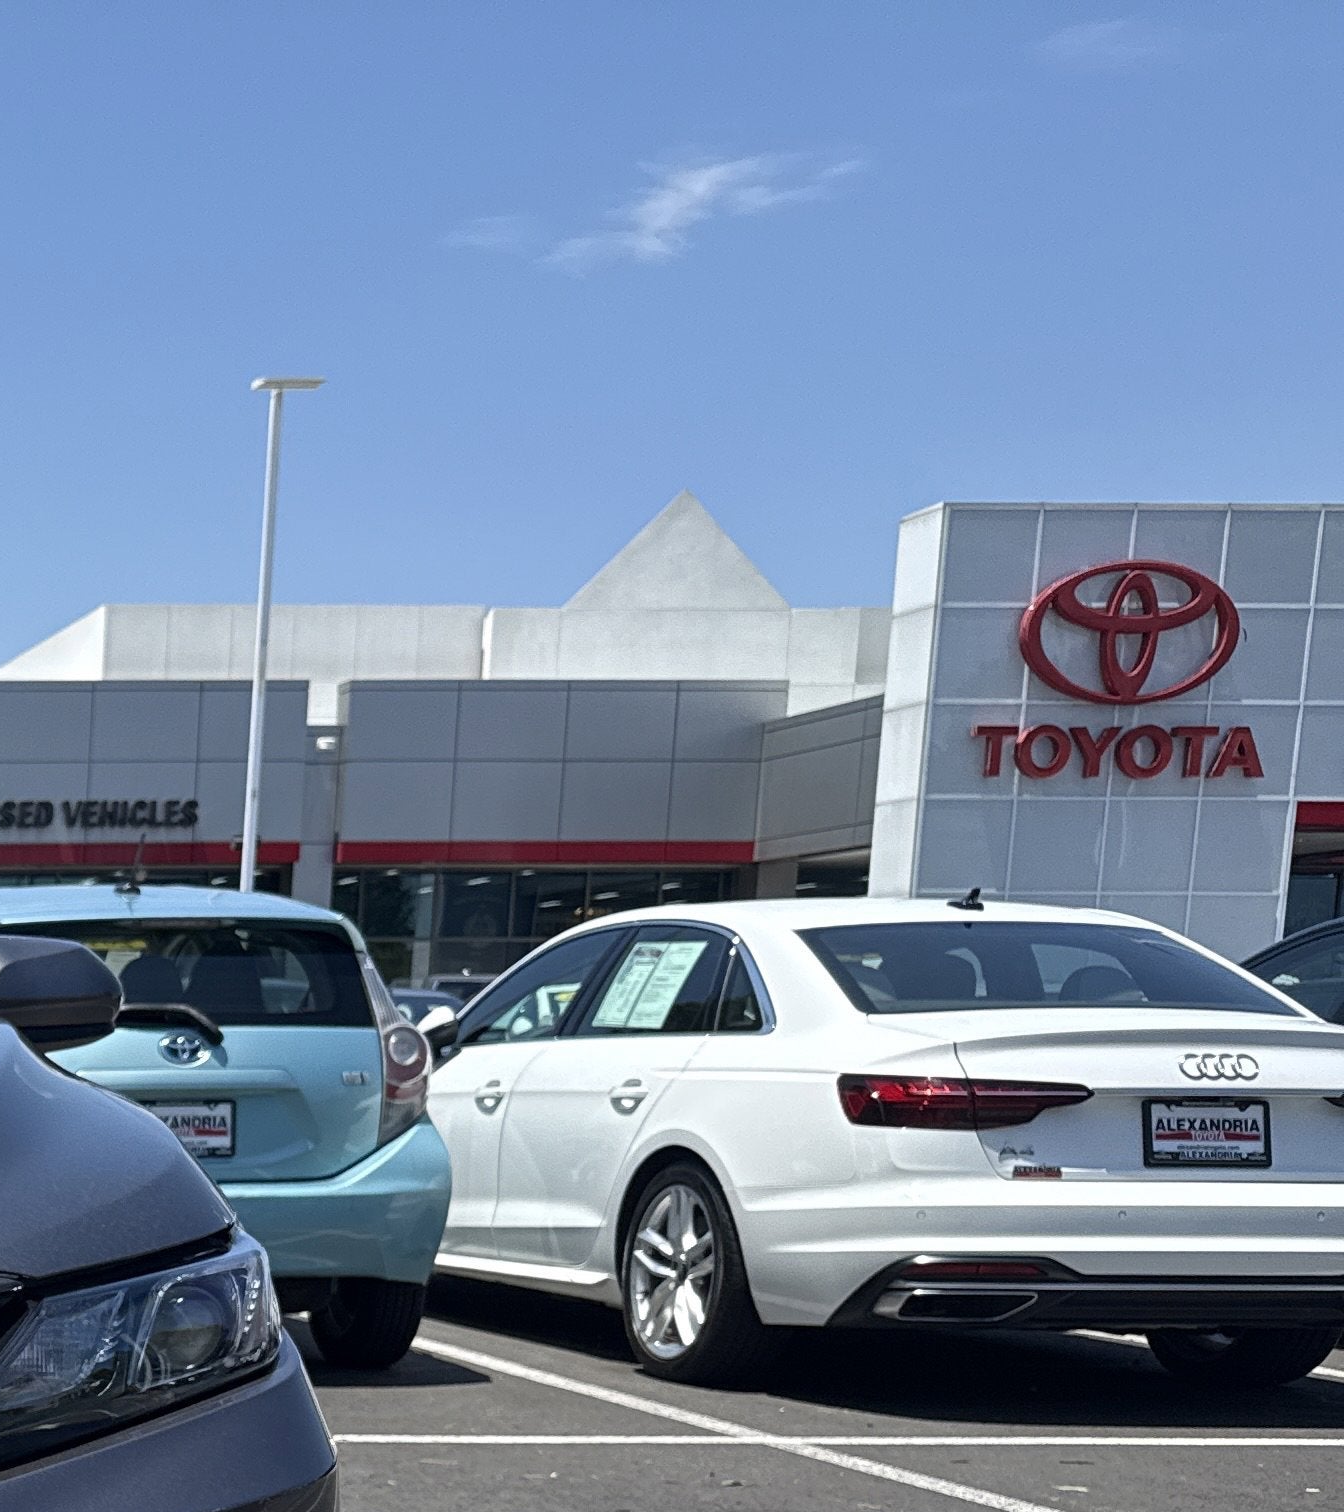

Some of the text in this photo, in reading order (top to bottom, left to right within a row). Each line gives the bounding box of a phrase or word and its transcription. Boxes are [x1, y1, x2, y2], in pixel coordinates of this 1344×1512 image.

[971, 724, 1265, 779] TOYOTA
[61, 800, 199, 829] VEHICLES
[1155, 1119, 1260, 1132] ALEXANDRIA
